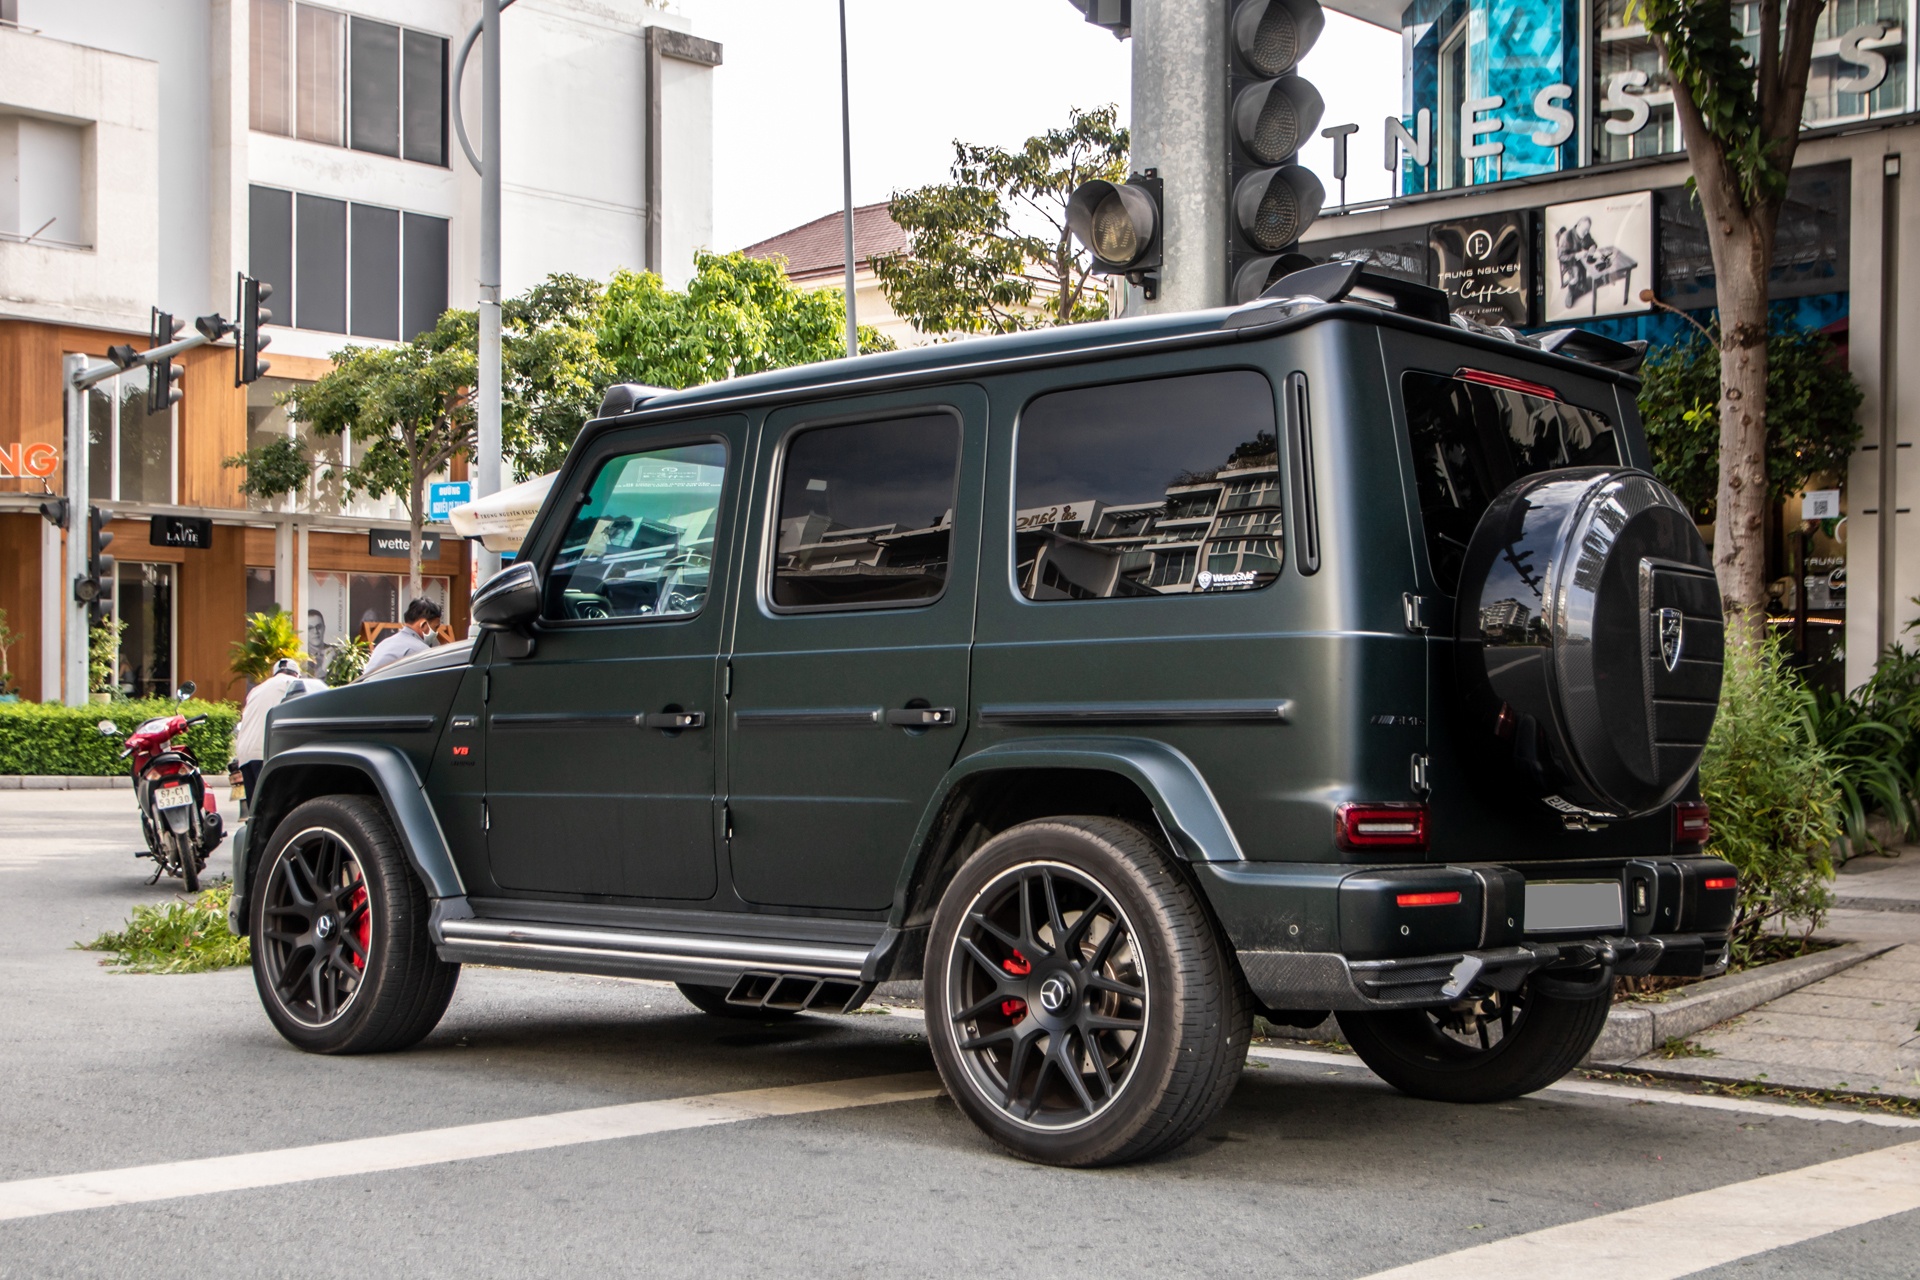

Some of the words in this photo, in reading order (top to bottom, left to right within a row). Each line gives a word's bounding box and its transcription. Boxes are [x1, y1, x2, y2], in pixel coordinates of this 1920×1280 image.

[1438, 269, 1473, 280] TRUNG
[1477, 263, 1521, 276] NGUYEN
[377, 538, 412, 551] wette
[453, 745, 469, 755] V8
